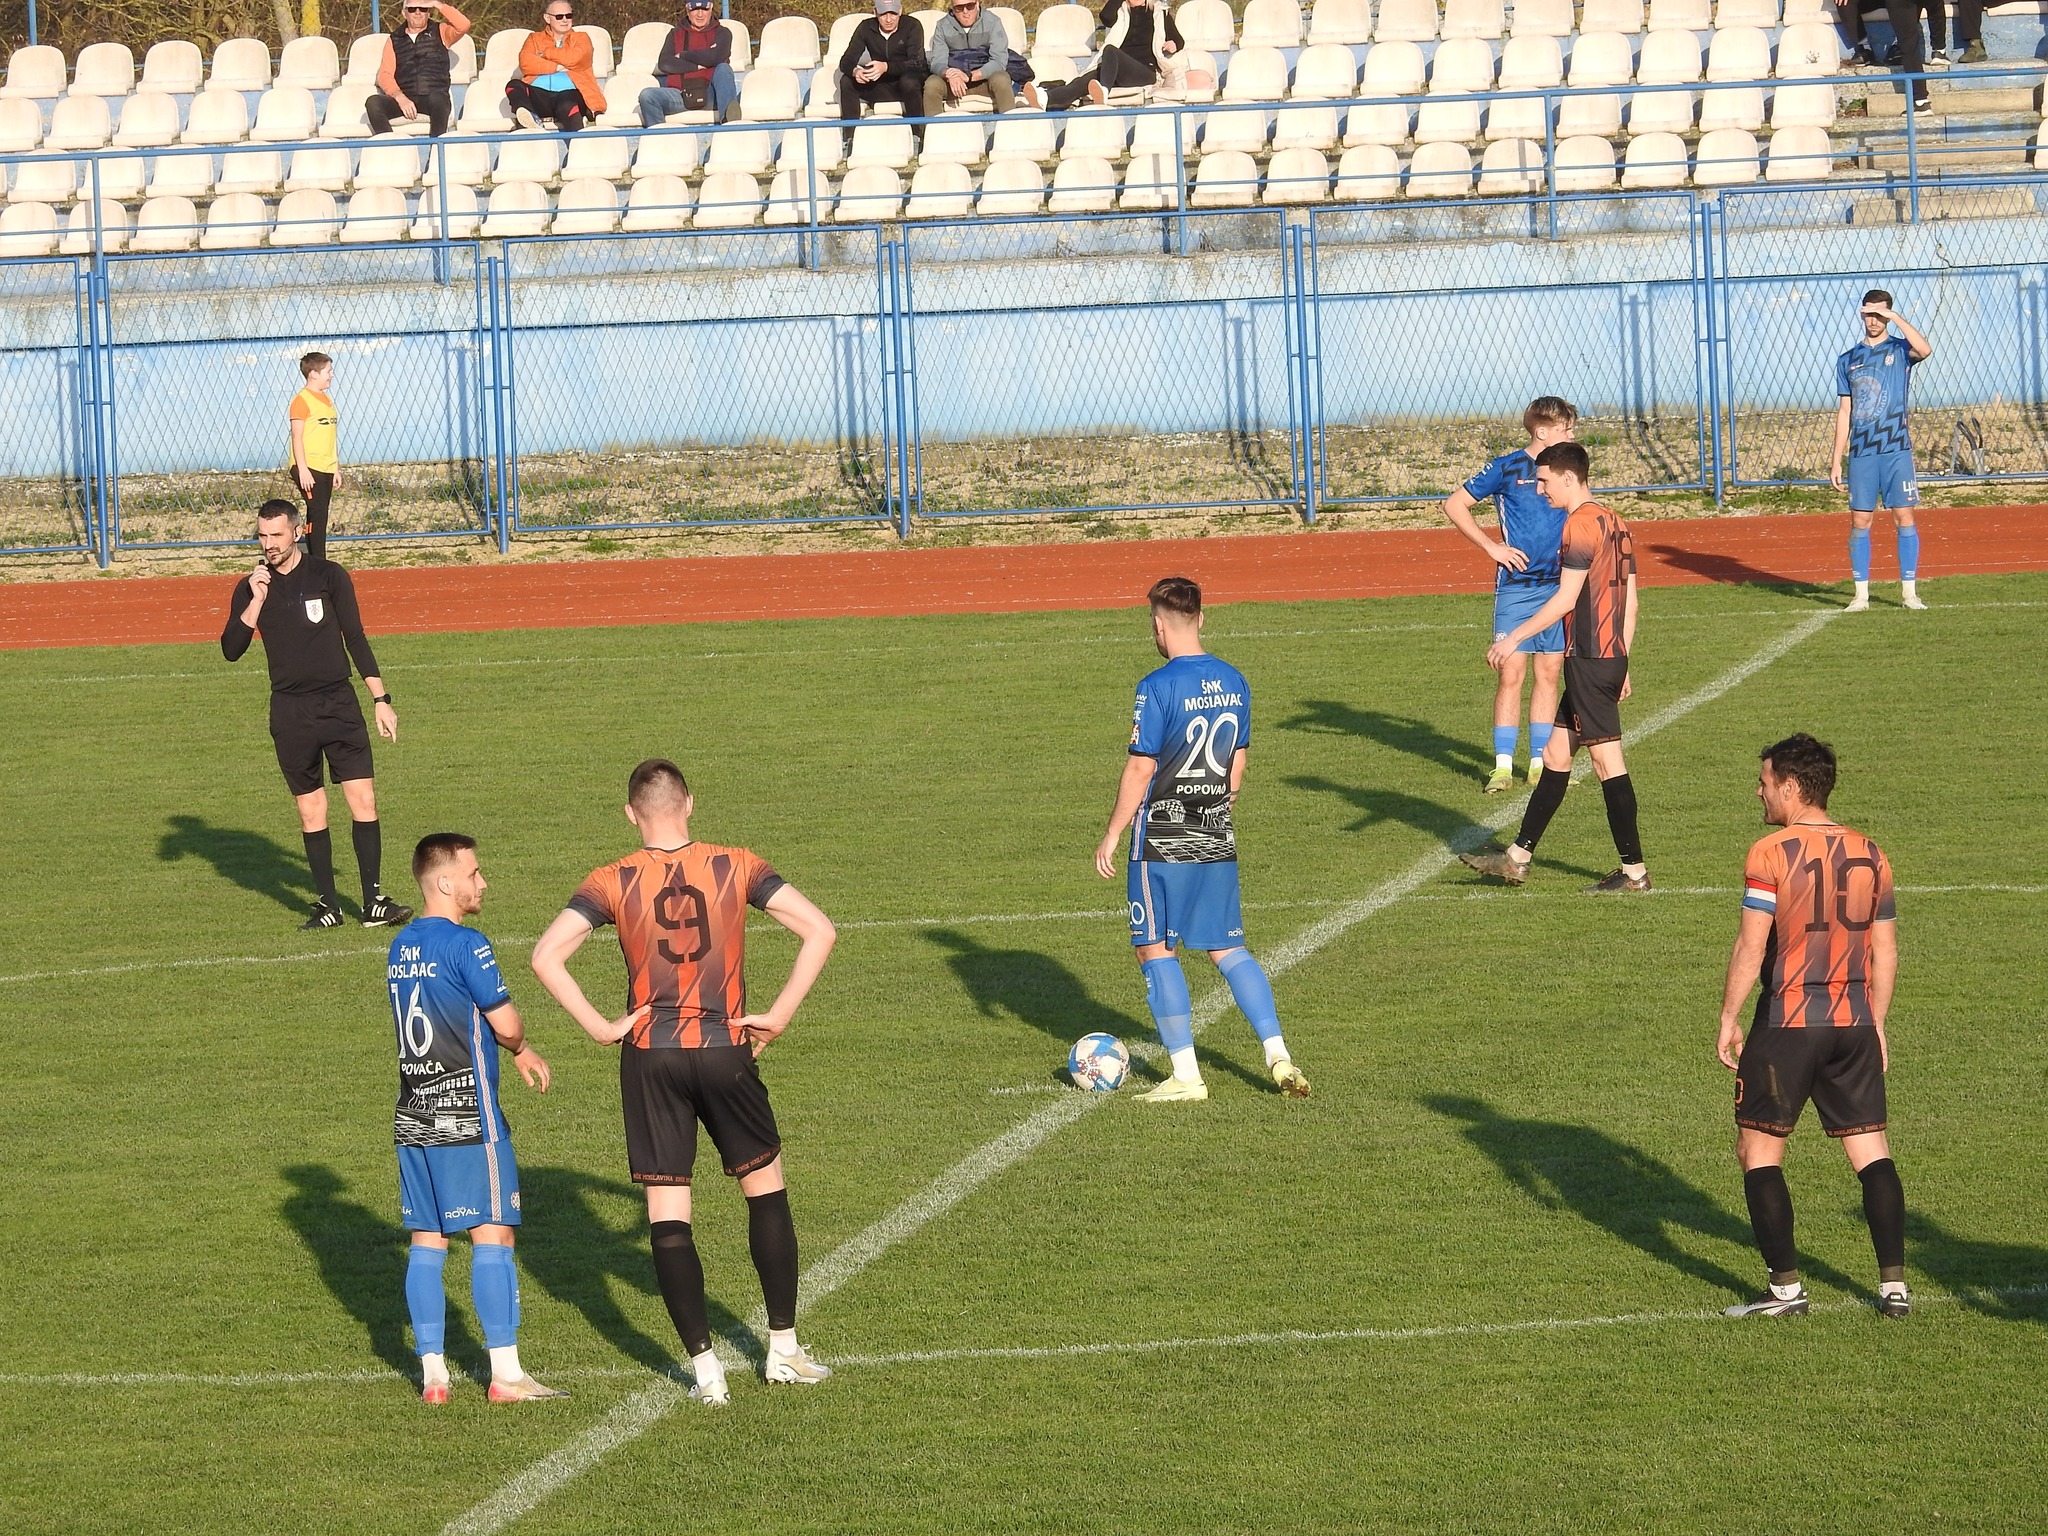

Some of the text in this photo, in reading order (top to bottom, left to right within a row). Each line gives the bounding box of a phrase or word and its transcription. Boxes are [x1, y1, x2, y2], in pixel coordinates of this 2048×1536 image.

[1201, 679, 1224, 695] ŠNK
[1184, 693, 1244, 712] MOSLAVAC
[1175, 712, 1239, 778] 20
[1803, 857, 1880, 933] 10
[653, 884, 712, 965] 9
[399, 944, 421, 962] ŠNK
[387, 961, 438, 980] OSLAAC
[388, 981, 434, 1059] 16
[444, 1207, 480, 1220] ROYAL
